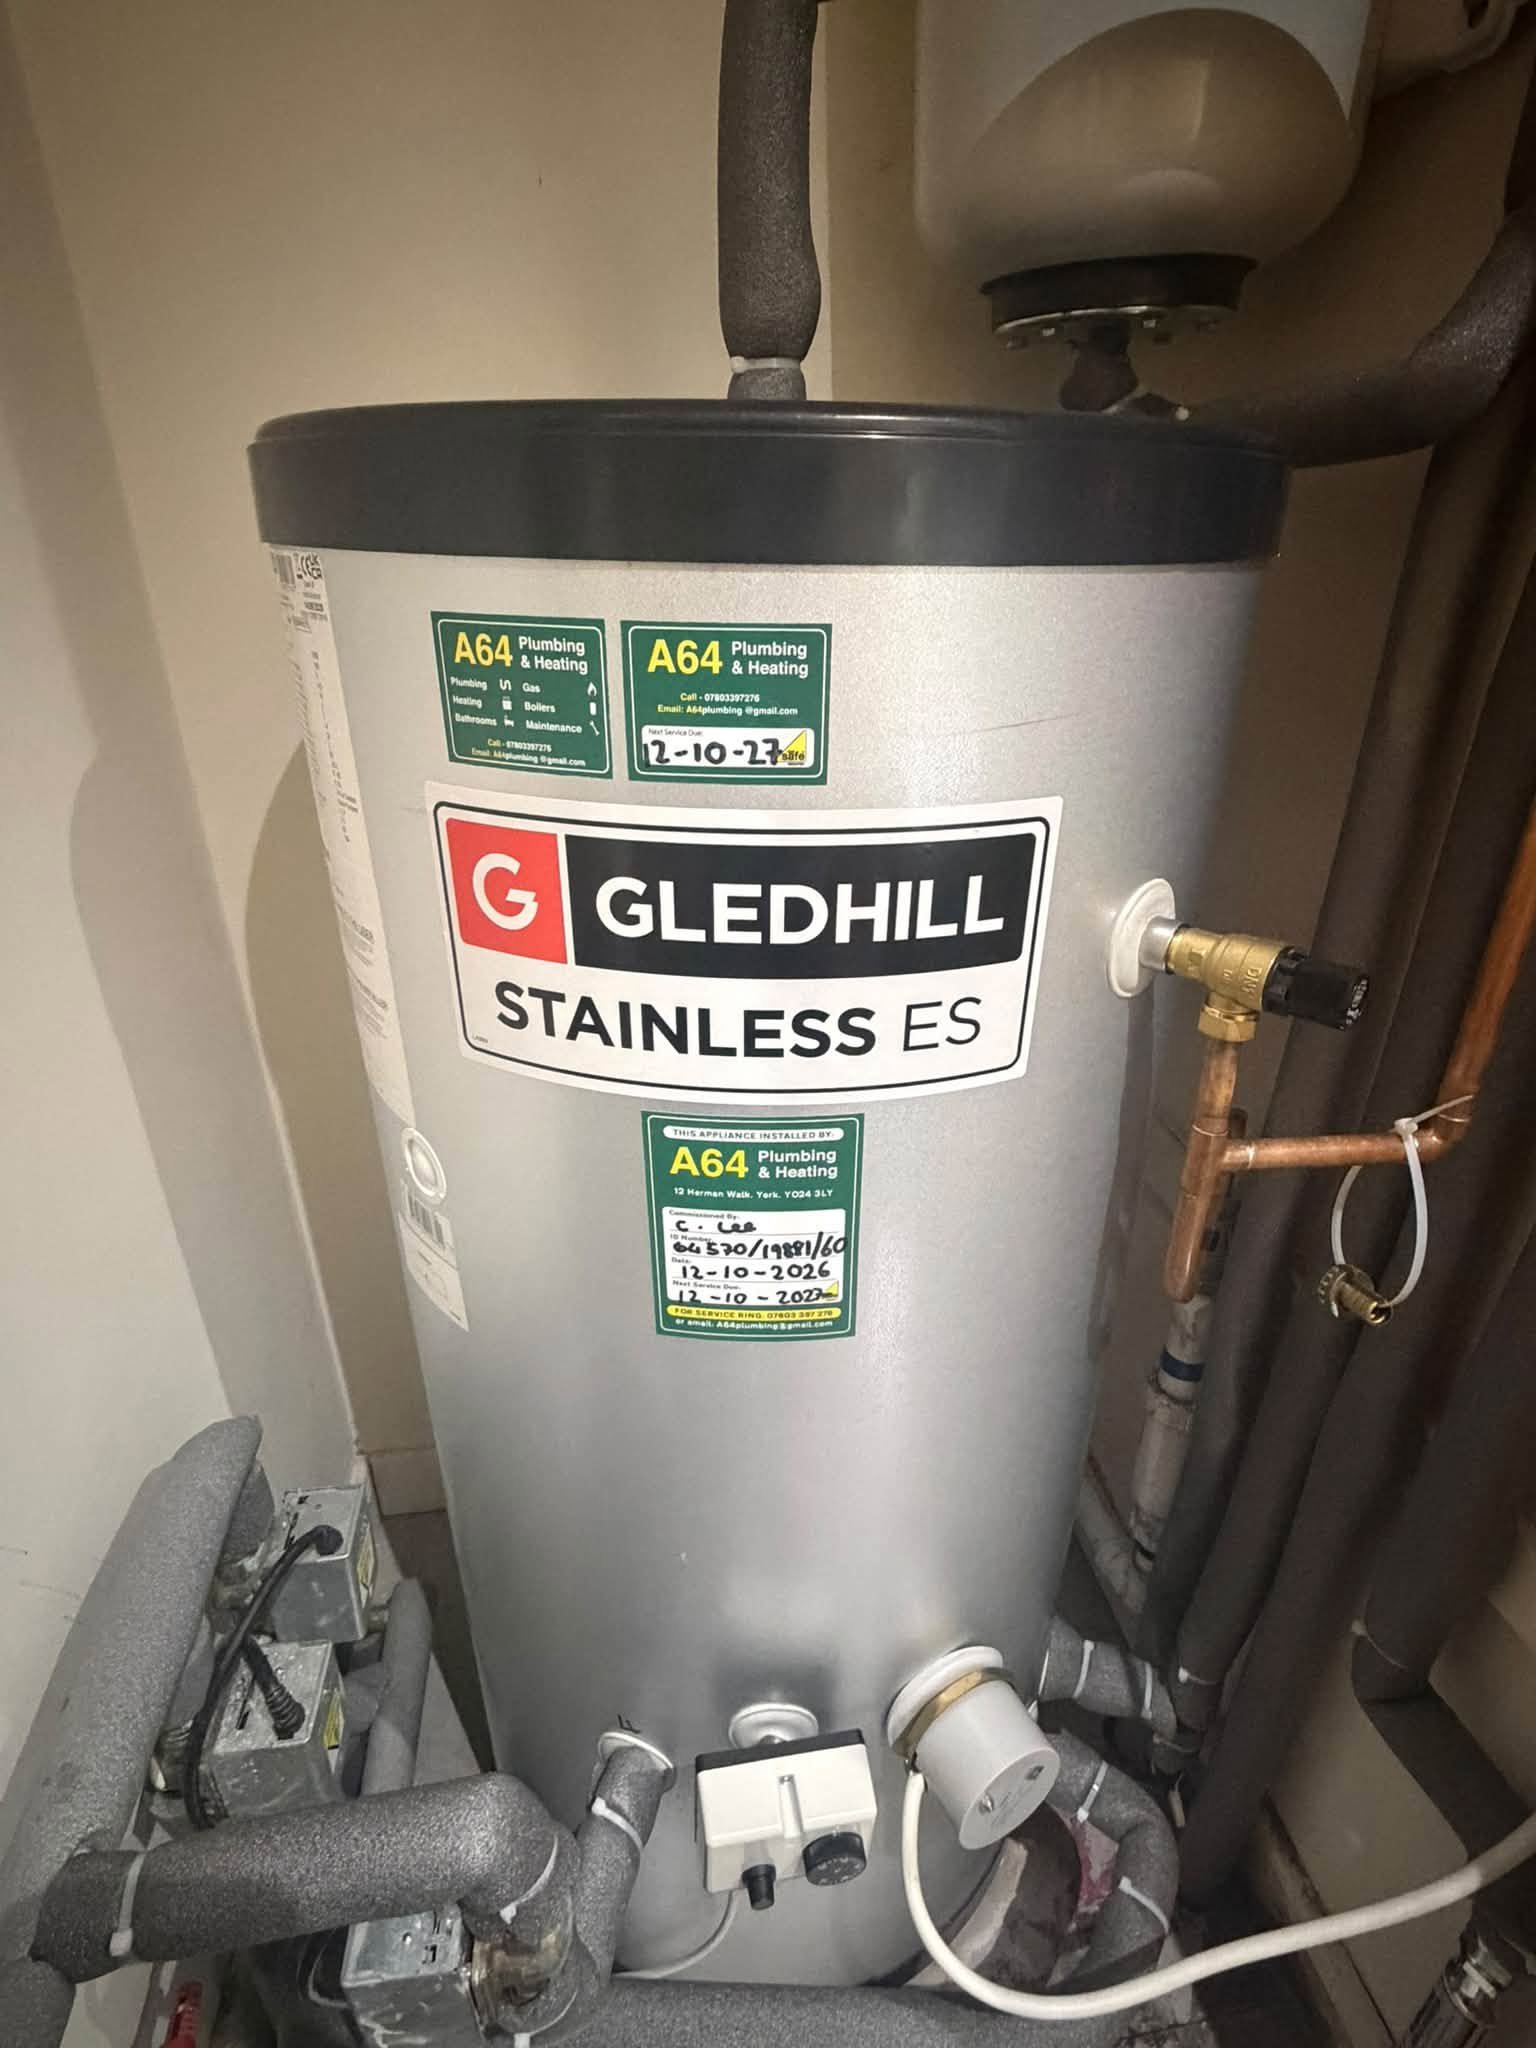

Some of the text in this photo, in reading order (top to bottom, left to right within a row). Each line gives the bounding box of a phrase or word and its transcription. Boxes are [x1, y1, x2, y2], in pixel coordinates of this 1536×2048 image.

[454, 631, 513, 667] A64
[518, 636, 585, 656] Plumbing
[732, 641, 807, 659] Plumbing
[647, 639, 723, 674] A64
[520, 655, 588, 675] & Heating
[732, 660, 809, 678] & Heating
[450, 676, 488, 691] Plumbing
[522, 682, 541, 693] Gas
[452, 695, 482, 709] Heating
[680, 693, 697, 702] Call
[524, 701, 555, 713] Boilers
[657, 704, 798, 717] Email: A64plumbing @gmail.com
[455, 713, 497, 726] Bathrooms
[526, 720, 582, 734] Maintenance
[665, 729, 687, 737] Service
[643, 738, 783, 768] 12-10-27
[471, 852, 538, 931] G
[595, 875, 1005, 945] GLEDHILL
[495, 981, 982, 1059] STAINLESS ES
[673, 1129, 697, 1137] THIS
[700, 1131, 756, 1140] APPLIANCE
[760, 1131, 816, 1140] INSTALLED
[669, 1146, 749, 1178] A64
[758, 1149, 837, 1163] Plumbing
[758, 1165, 838, 1180] & Heating
[674, 1187, 684, 1195] 12
[785, 1190, 811, 1198] YO24
[814, 1189, 833, 1197] 3LY
[682, 1261, 831, 1280] 12-10-2026
[695, 1309, 736, 1318] SERVICE
